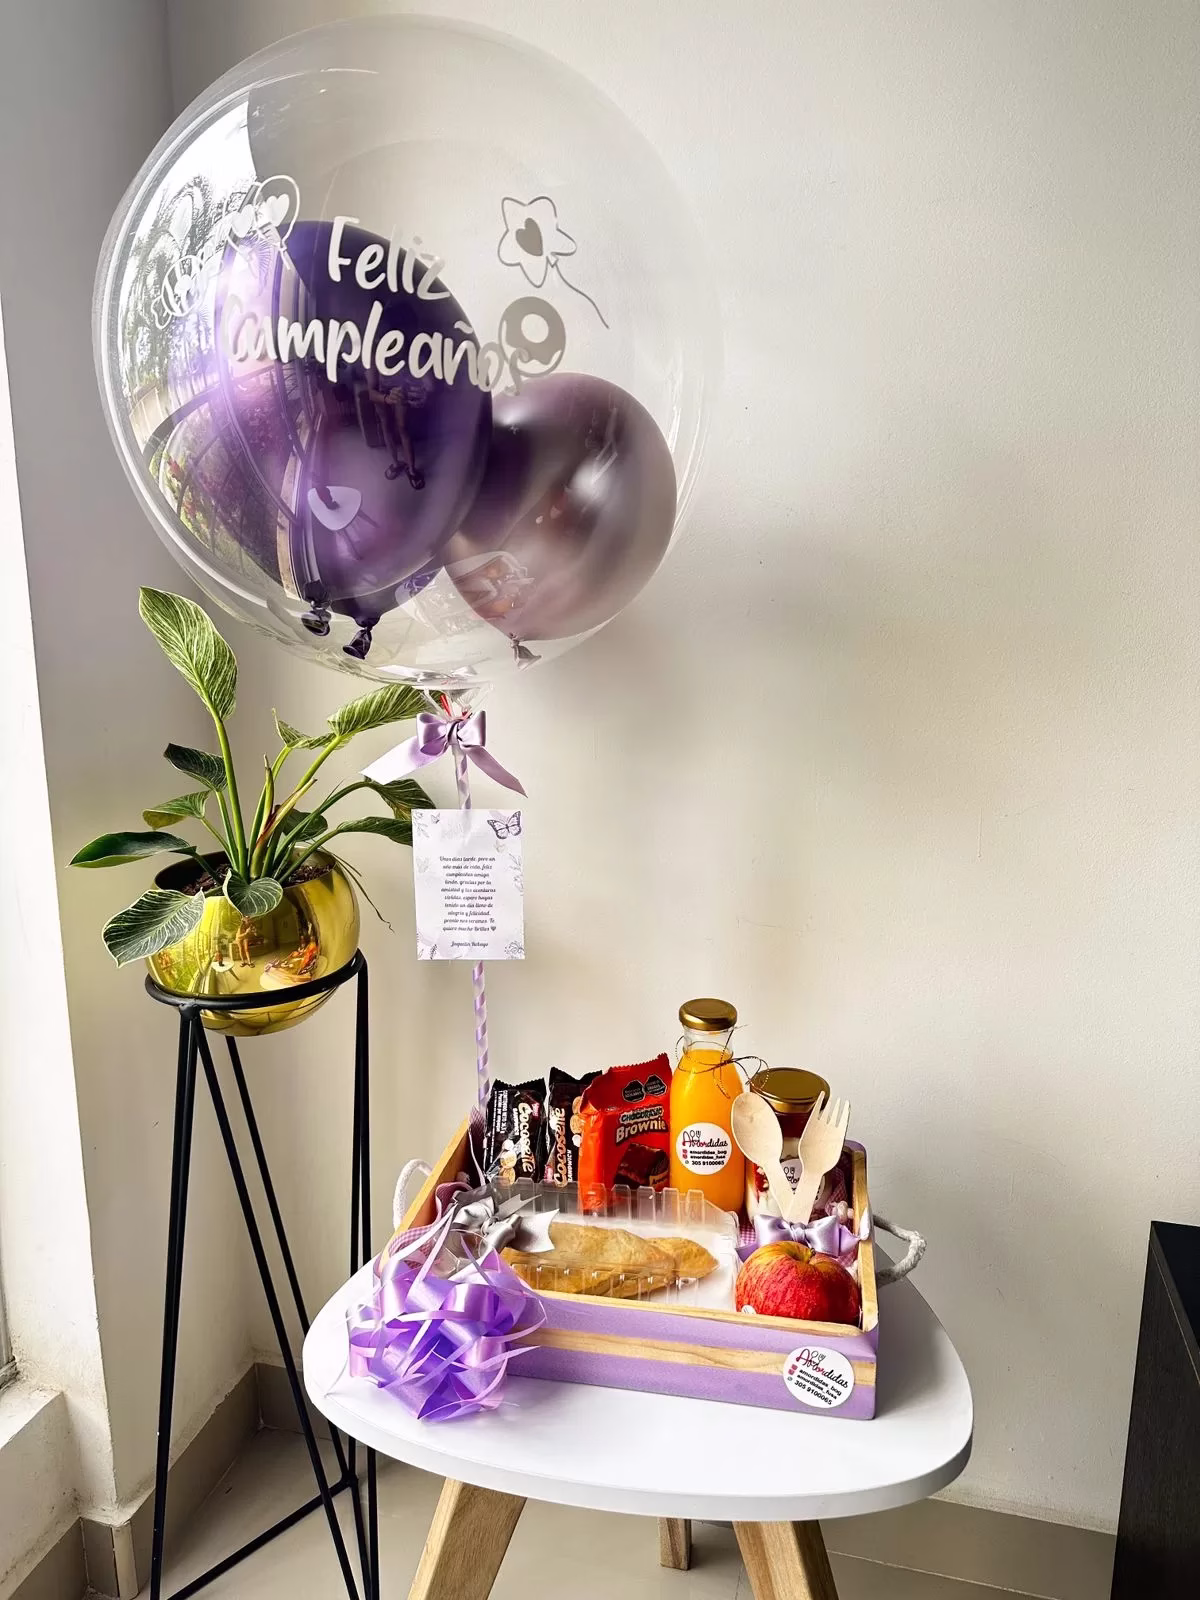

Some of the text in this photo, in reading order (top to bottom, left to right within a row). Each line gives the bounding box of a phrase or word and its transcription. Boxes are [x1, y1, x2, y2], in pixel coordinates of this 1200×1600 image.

[327, 216, 450, 301] Feliz
[518, 1102, 536, 1173] Cocosette
[553, 1107, 568, 1188] Cocosette
[616, 1117, 666, 1143] Brownie
[794, 1380, 806, 1390] 305
